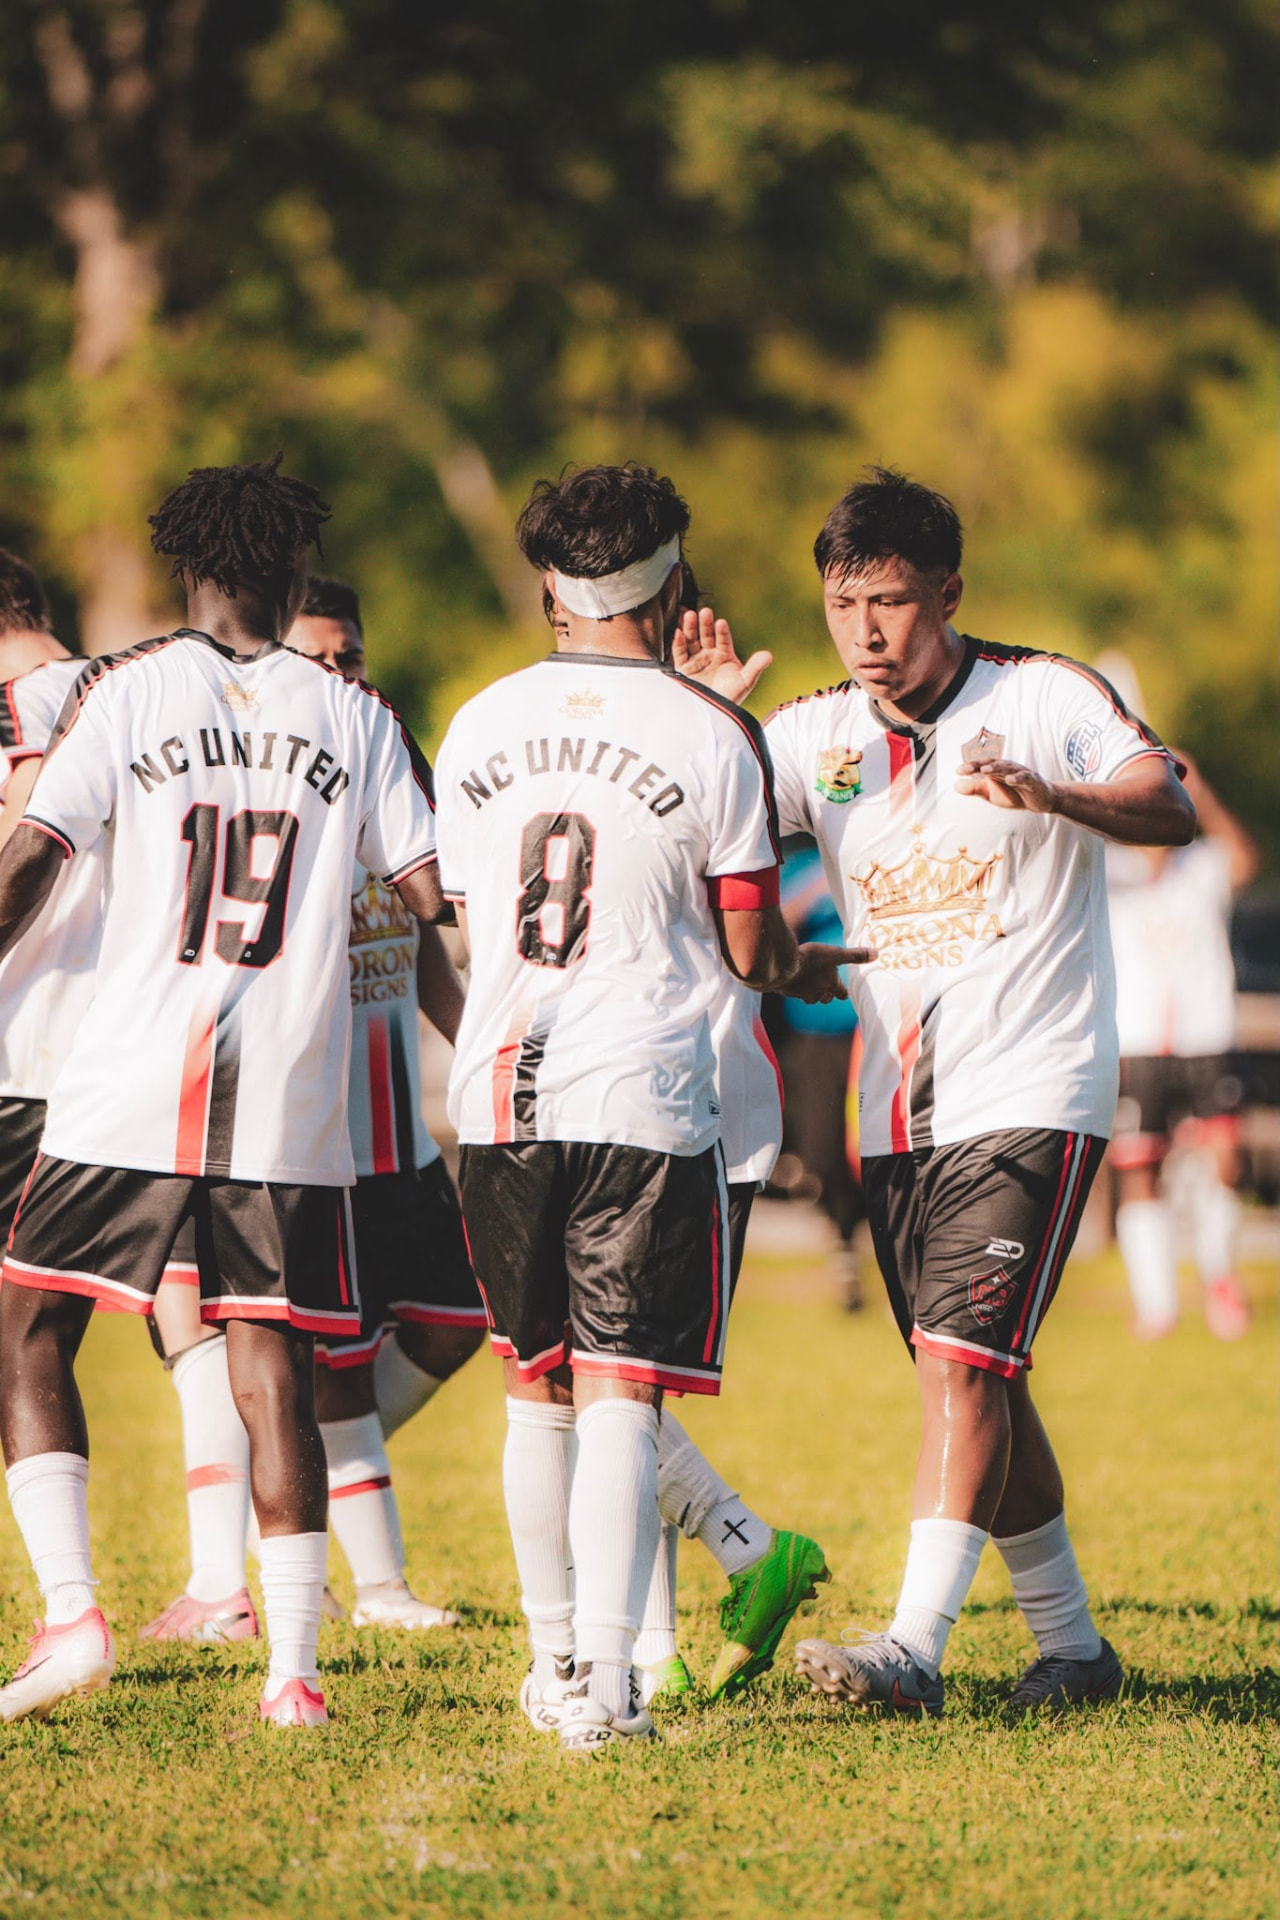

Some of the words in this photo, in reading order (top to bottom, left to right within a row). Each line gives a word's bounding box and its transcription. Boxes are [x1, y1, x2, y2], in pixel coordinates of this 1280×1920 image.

[129, 735, 190, 794] NC
[199, 728, 350, 806] UNITED
[460, 751, 515, 810] NC
[525, 737, 685, 817] UNITED
[1074, 727, 1098, 777] UPSL
[175, 802, 300, 970] 19
[515, 812, 597, 970] 8
[350, 975, 409, 1006] SIGNS
[876, 944, 965, 971] SIGNS
